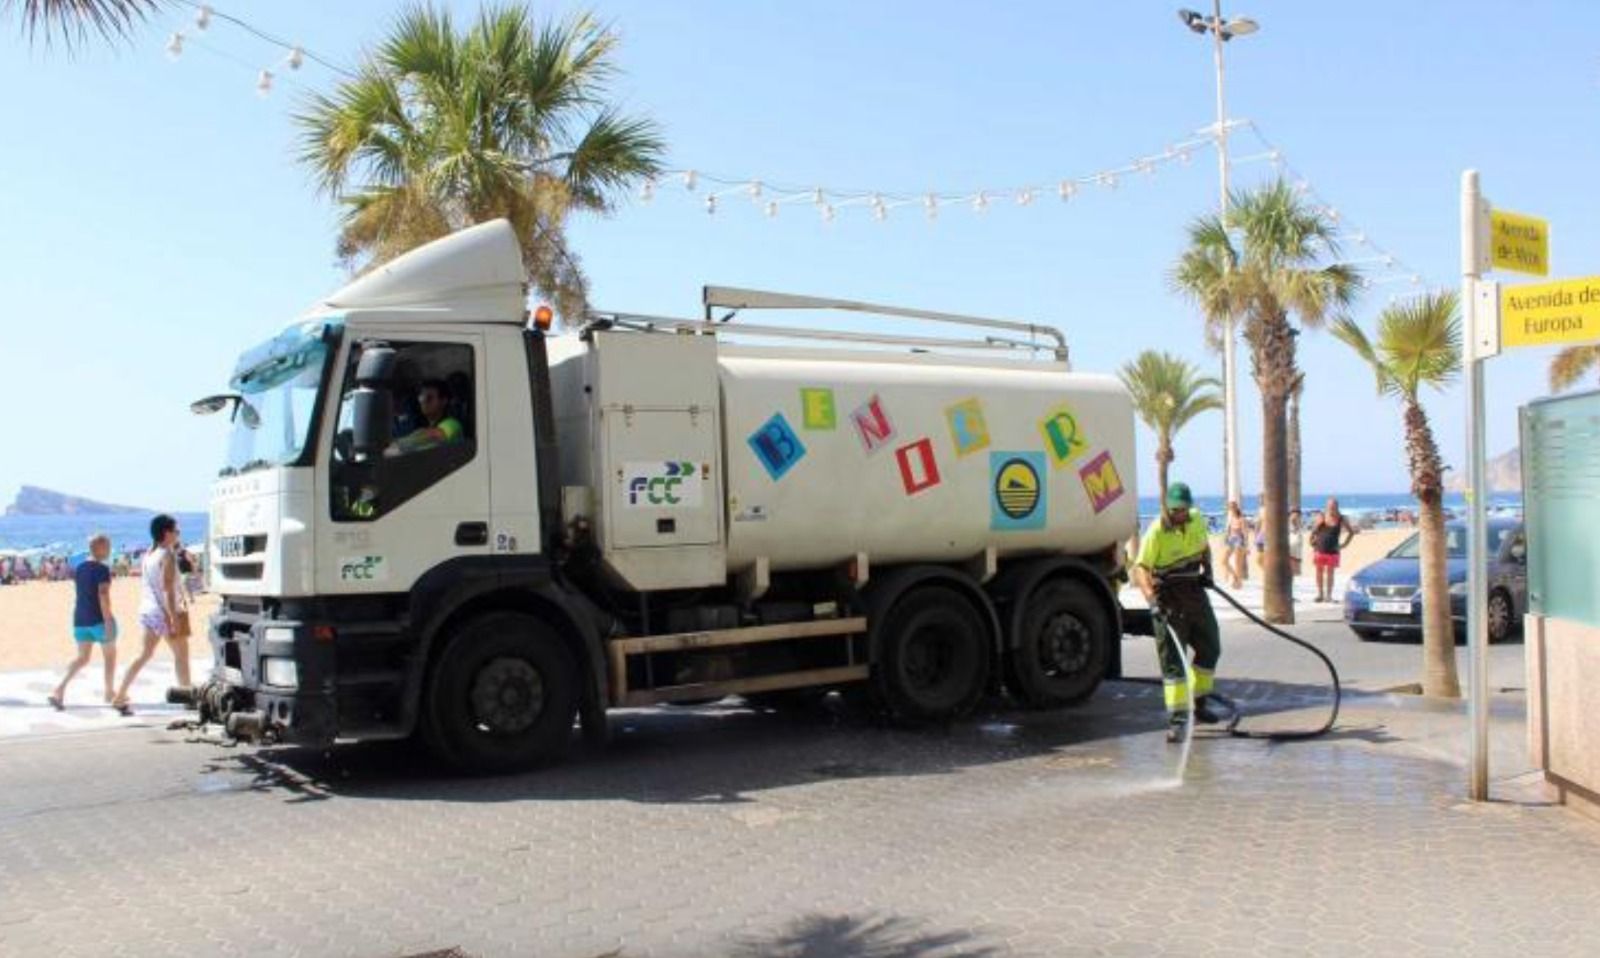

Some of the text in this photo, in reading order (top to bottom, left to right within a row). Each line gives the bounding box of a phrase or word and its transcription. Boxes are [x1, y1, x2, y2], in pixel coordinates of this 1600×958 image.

[1509, 286, 1600, 311] Avenida de
[1524, 316, 1583, 335] Europa
[629, 477, 682, 505] FCC
[341, 564, 375, 580] FCC
